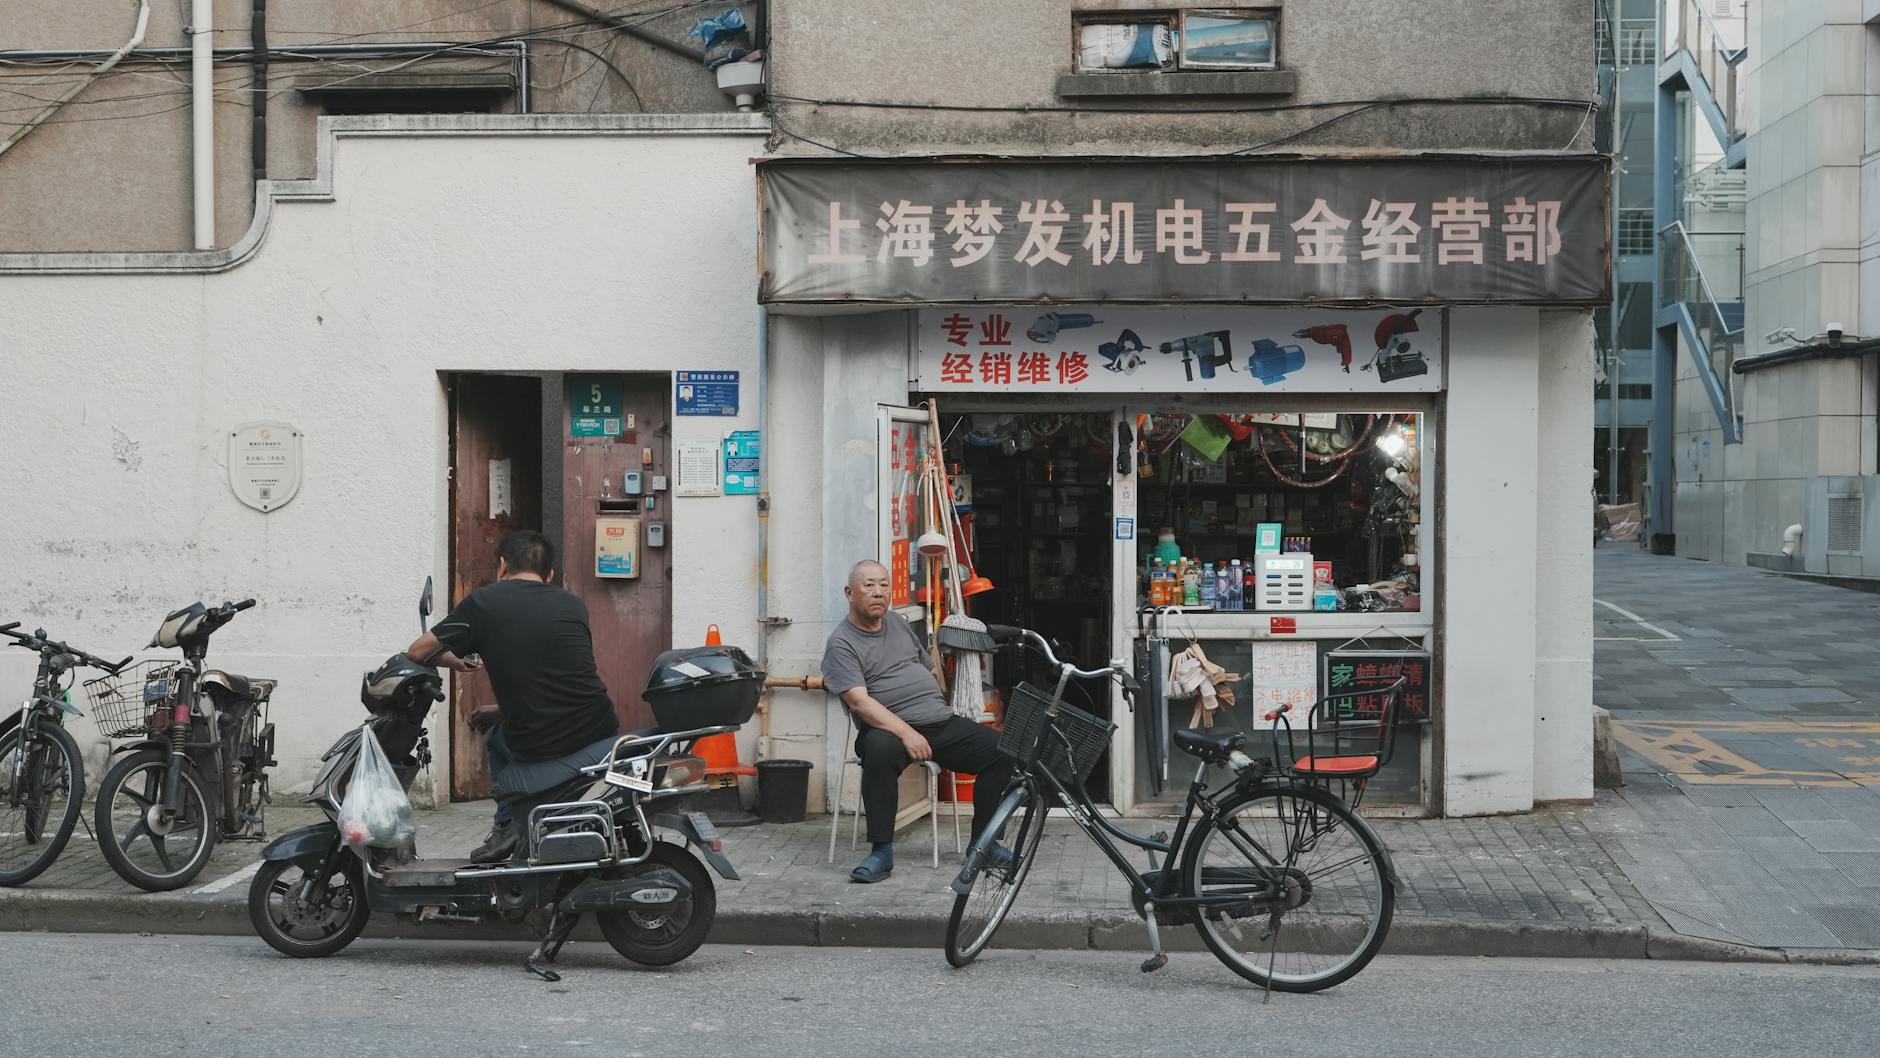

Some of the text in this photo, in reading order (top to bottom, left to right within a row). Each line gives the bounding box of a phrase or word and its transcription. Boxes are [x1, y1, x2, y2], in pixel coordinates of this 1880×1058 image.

[808, 197, 1561, 268] 上海梦发机电五金经营部
[941, 313, 1011, 347] 专业
[941, 351, 1089, 385] 经销维修
[591, 384, 602, 403] 5
[1356, 692, 1426, 718] 粘板
